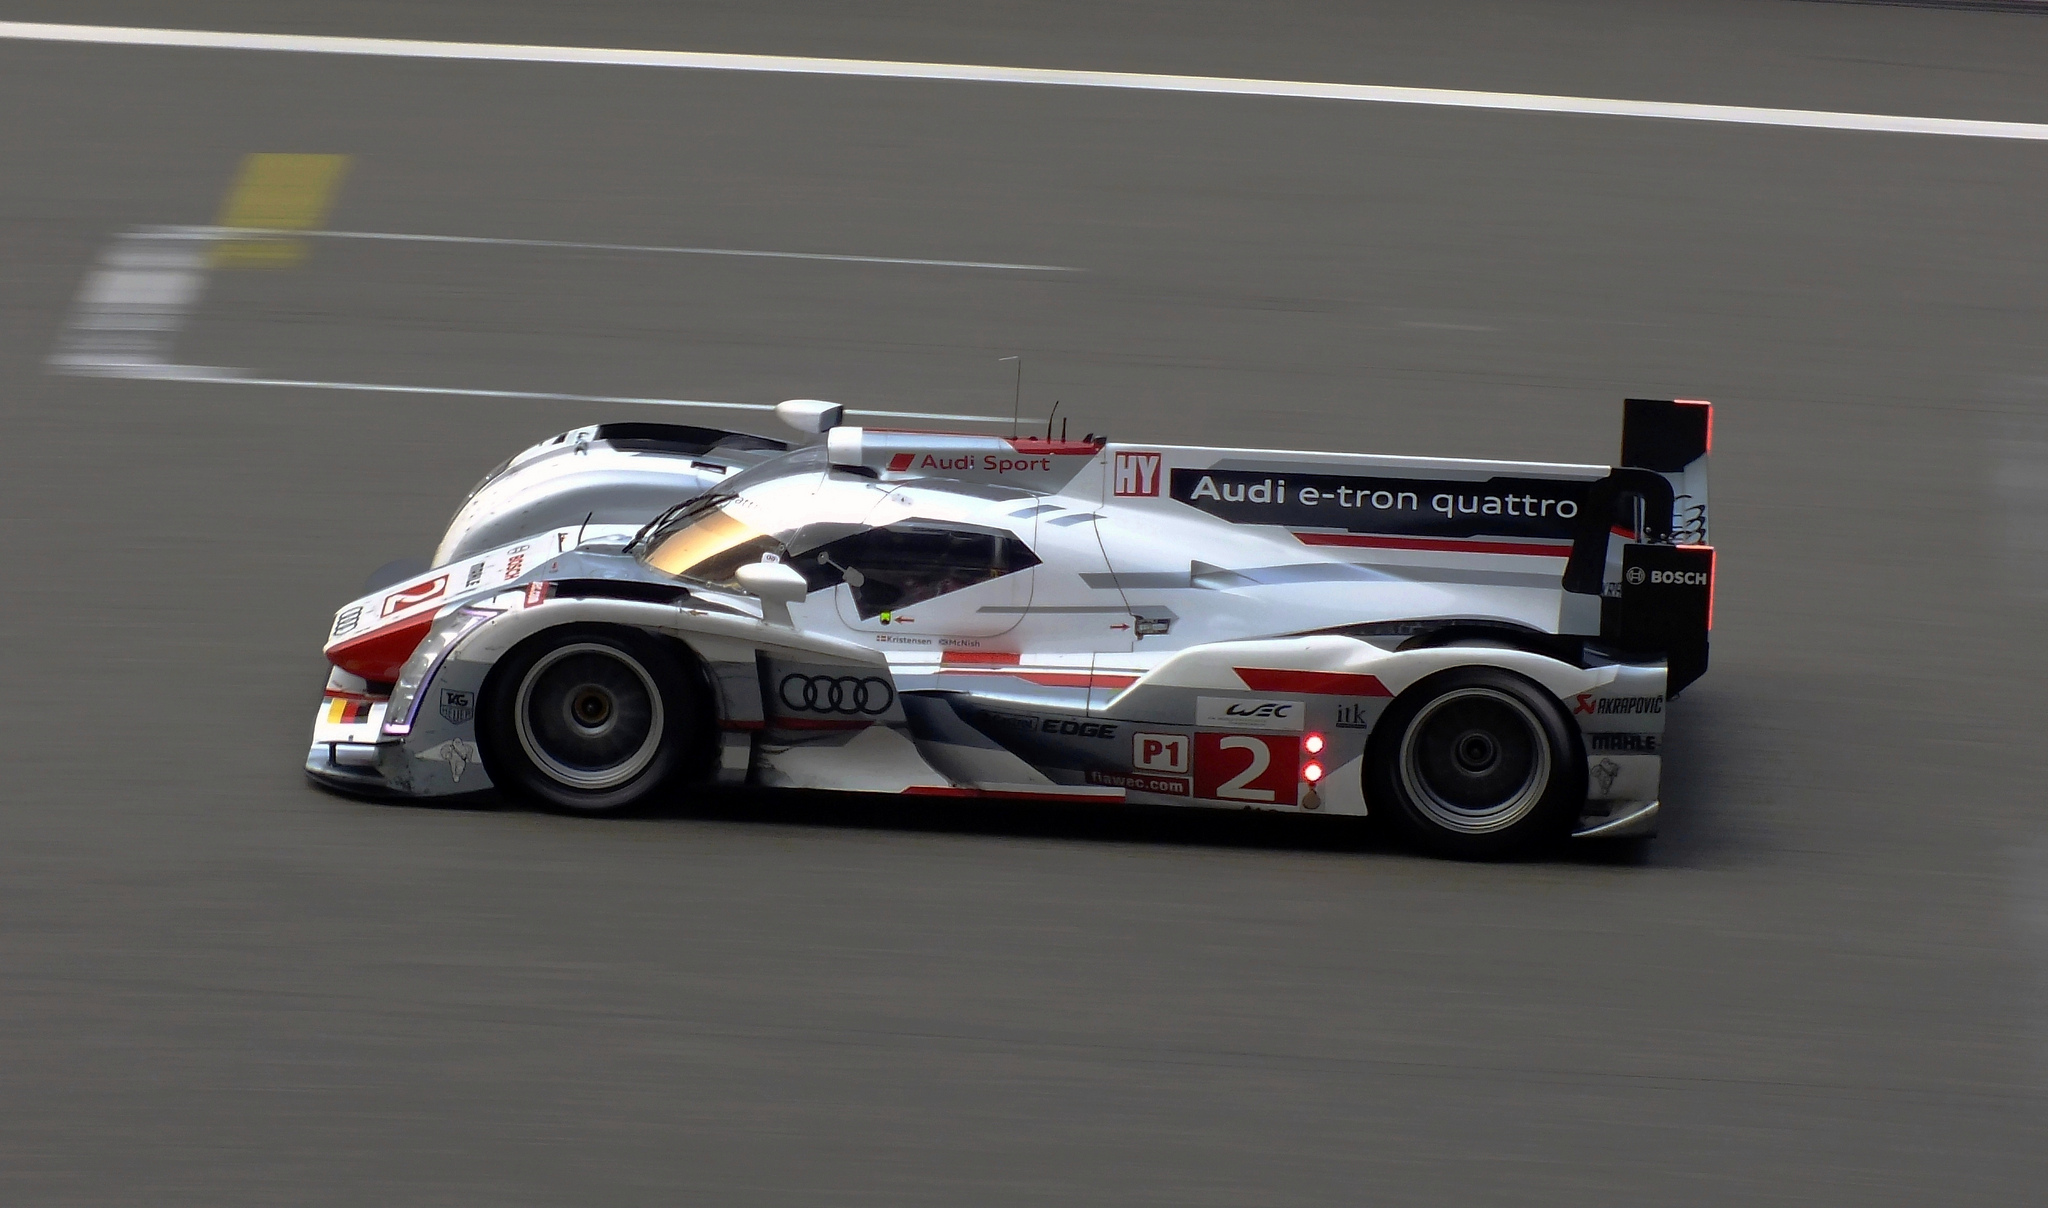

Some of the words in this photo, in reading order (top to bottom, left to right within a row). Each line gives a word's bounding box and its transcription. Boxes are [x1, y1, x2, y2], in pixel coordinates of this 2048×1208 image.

[920, 453, 975, 470] Audi
[983, 455, 1050, 474] Sport
[1115, 454, 1160, 494] HY
[1190, 474, 1286, 504] Audi
[1299, 484, 1418, 511] e-tron
[1432, 492, 1579, 519] quattro
[1650, 570, 1707, 586] BOSCH
[887, 636, 932, 645] Kristensen
[949, 640, 981, 648] McNish
[1226, 703, 1292, 718] WEC
[1042, 719, 1119, 739] EDGE
[1142, 739, 1179, 767] P1
[1216, 735, 1276, 802] 2
[1091, 770, 1184, 793] fiawec.com
